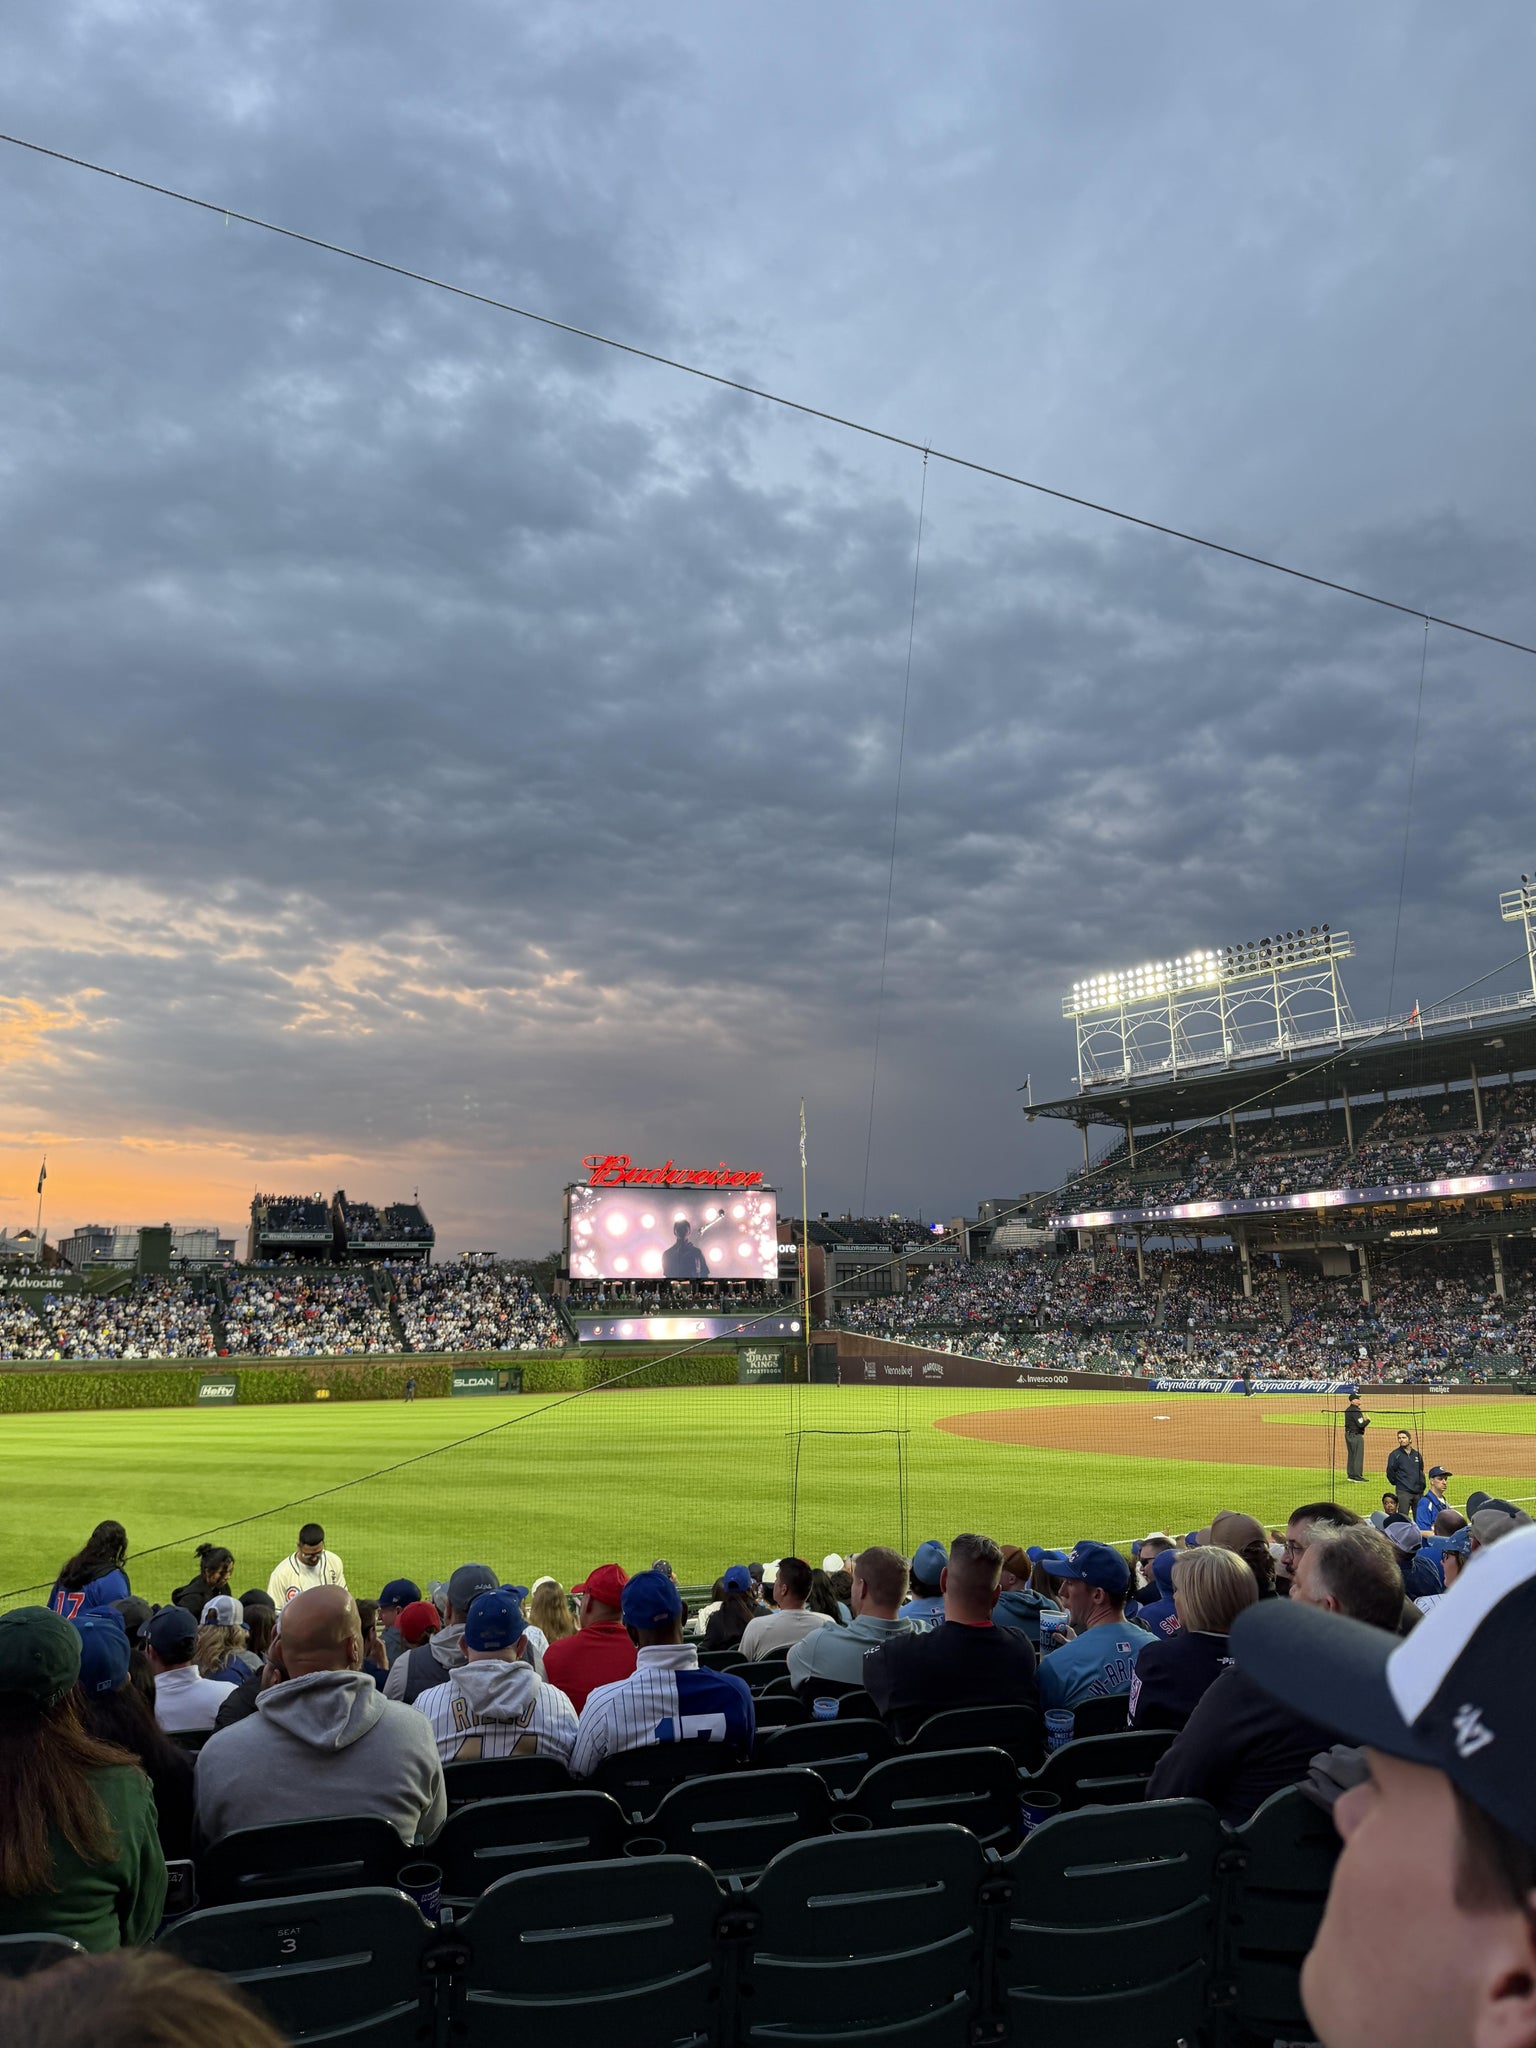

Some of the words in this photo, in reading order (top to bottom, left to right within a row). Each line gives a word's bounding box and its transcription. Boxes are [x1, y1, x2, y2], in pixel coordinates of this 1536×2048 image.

[582, 1154, 764, 1186] Budweiser
[10, 1276, 64, 1288] Advocate
[1027, 1374, 1053, 1383] Invesco
[1053, 1375, 1068, 1383] QQQ
[202, 1386, 233, 1396] Hefty
[1156, 1380, 1197, 1392] Reynolds
[1198, 1380, 1223, 1393] Wrap
[1252, 1380, 1298, 1392] Reynolds
[1299, 1380, 1327, 1393] Wrap
[56, 1591, 85, 1620] 17
[278, 1927, 301, 1936] SEAT
[280, 1938, 297, 1953] 3
